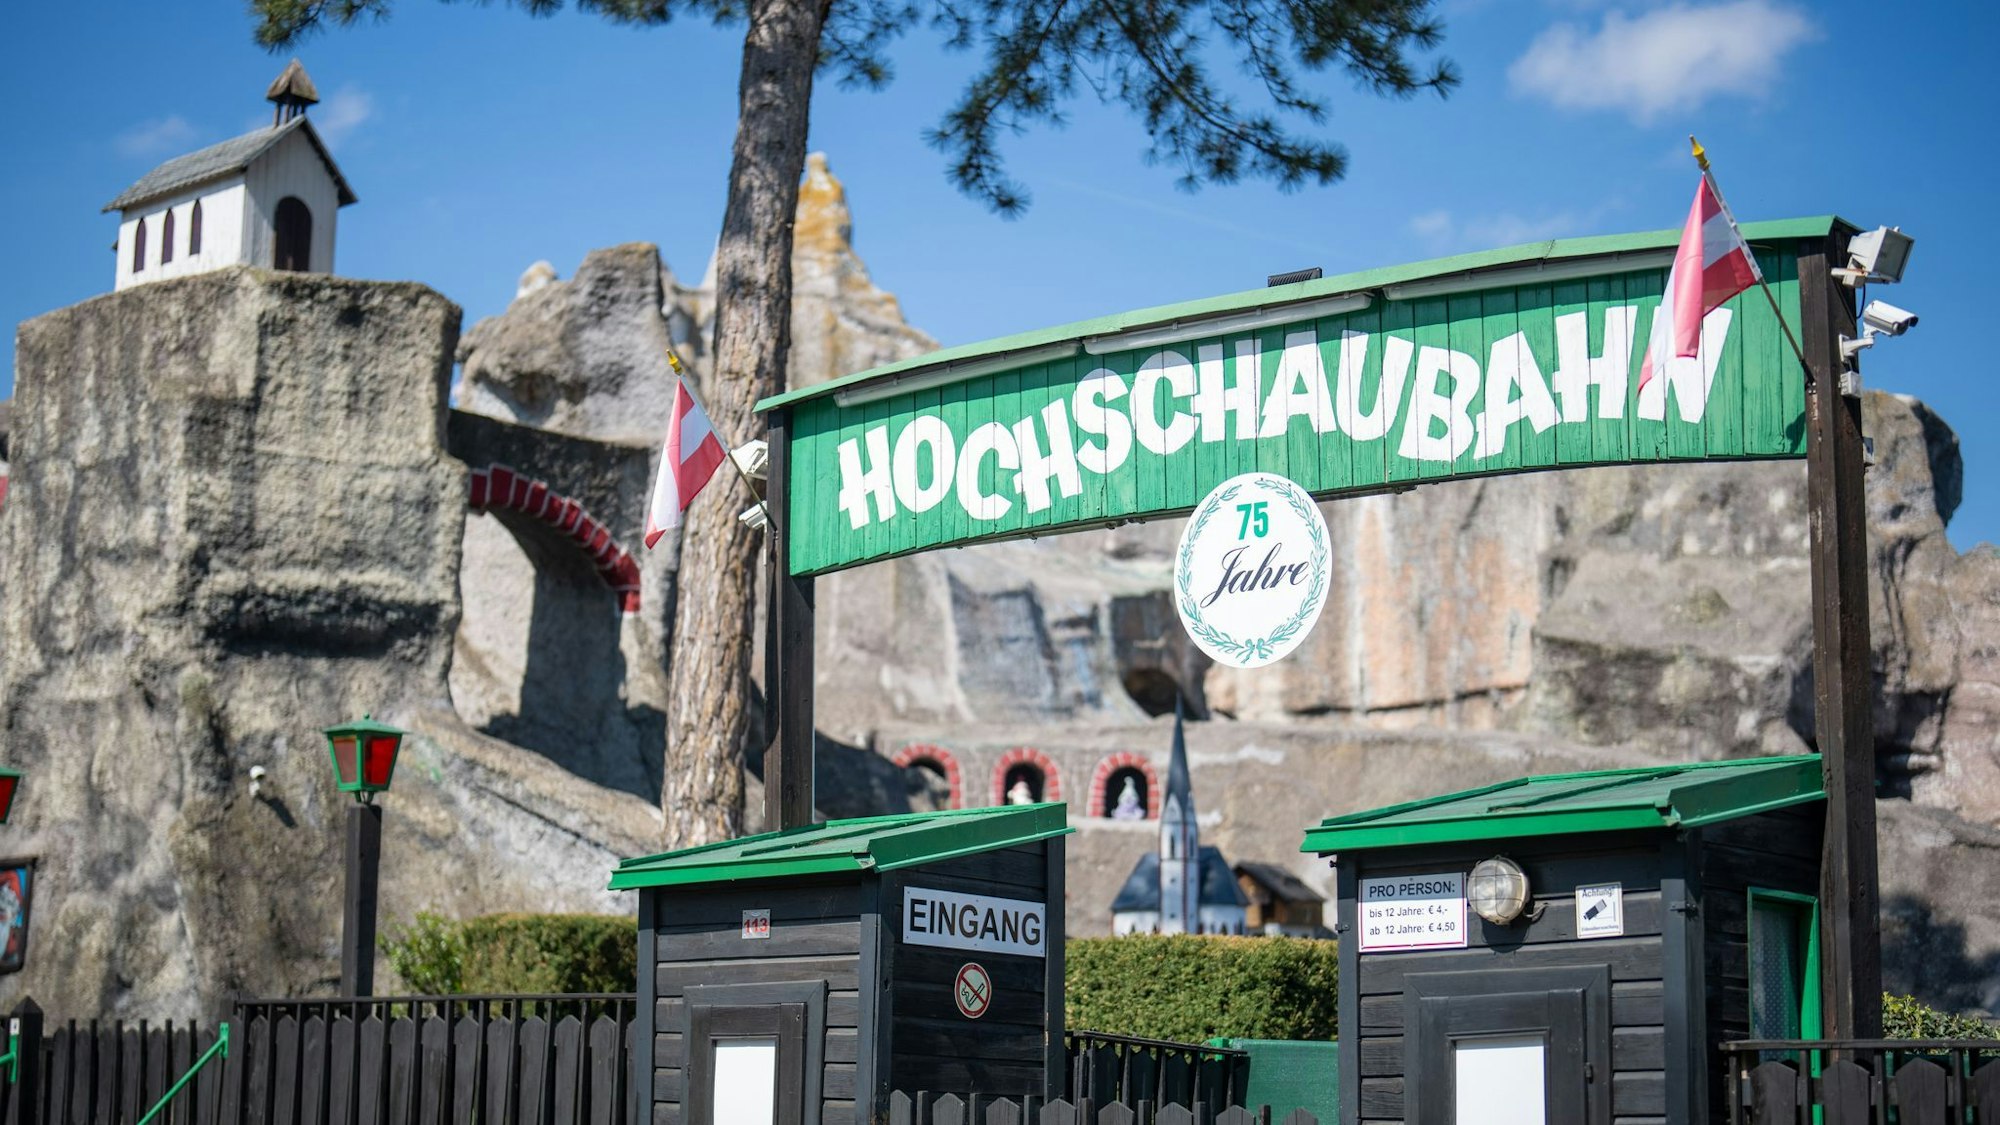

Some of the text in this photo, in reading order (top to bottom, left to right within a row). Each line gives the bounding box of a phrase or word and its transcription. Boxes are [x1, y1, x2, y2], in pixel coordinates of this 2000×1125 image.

[837, 305, 1733, 531] HOCHSCHAUBAHN
[1236, 501, 1269, 541] 75
[1200, 542, 1310, 608] Jahre
[1369, 881, 1455, 898] PRO PERSON:
[744, 917, 768, 933] 113
[909, 898, 1041, 946] EINGANG
[1369, 908, 1383, 918] bis
[1385, 907, 1395, 917] 12
[1397, 906, 1425, 917] Jahre:
[1428, 905, 1434, 915] €
[1369, 921, 1456, 936] ab 12 Jahre: € 4,50
